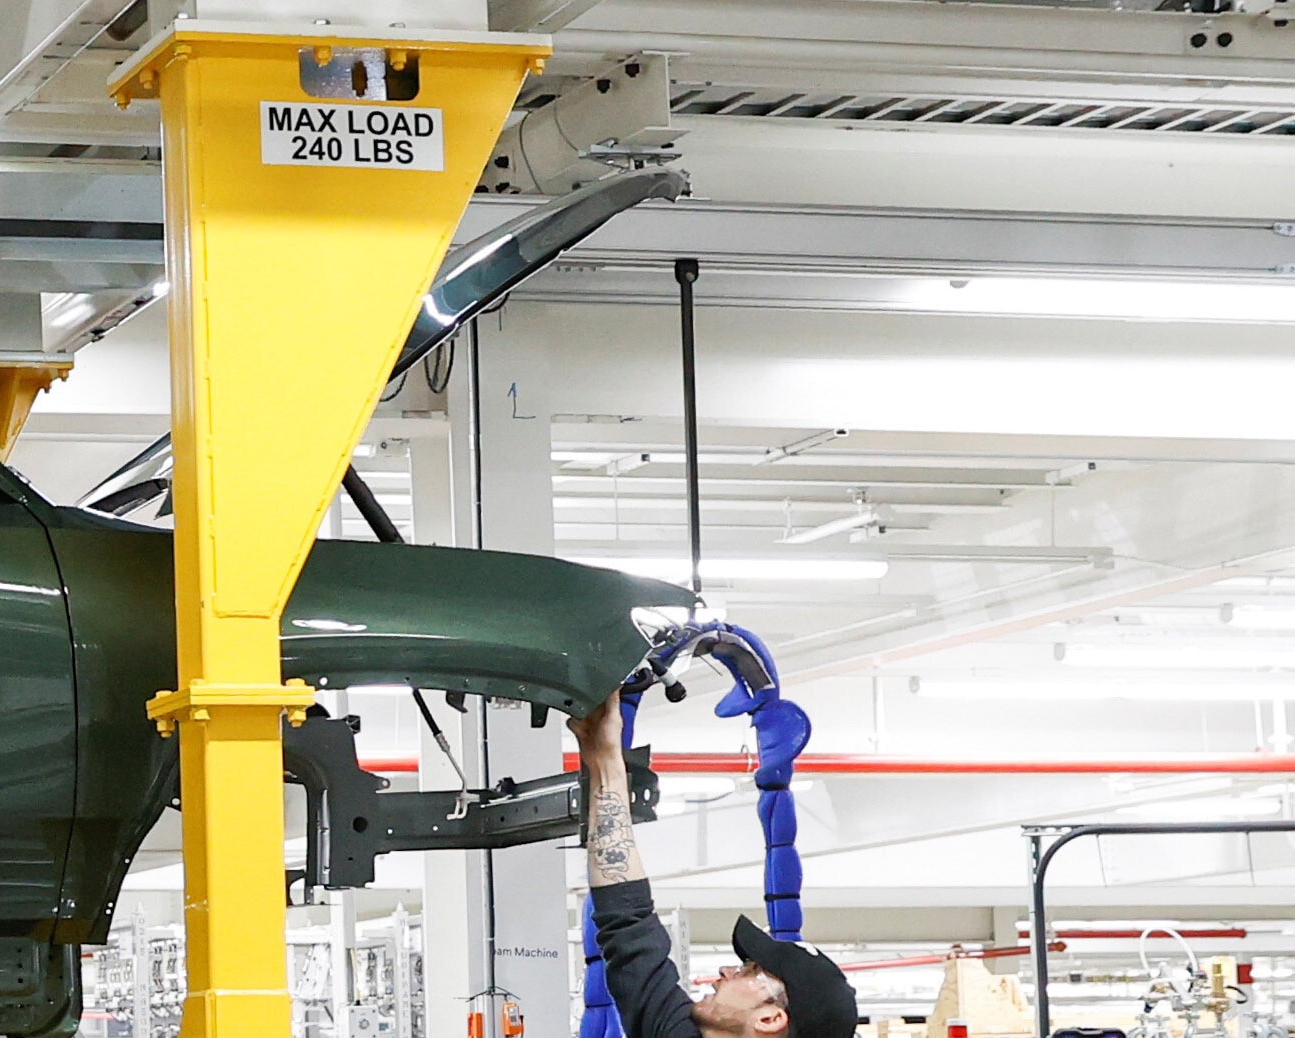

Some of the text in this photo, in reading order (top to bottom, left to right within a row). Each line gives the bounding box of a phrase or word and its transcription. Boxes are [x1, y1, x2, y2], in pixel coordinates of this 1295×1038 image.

[268, 107, 434, 137] MAX LOAD
[291, 136, 414, 164] 240 LBS
[494, 947, 559, 958] am Machine
